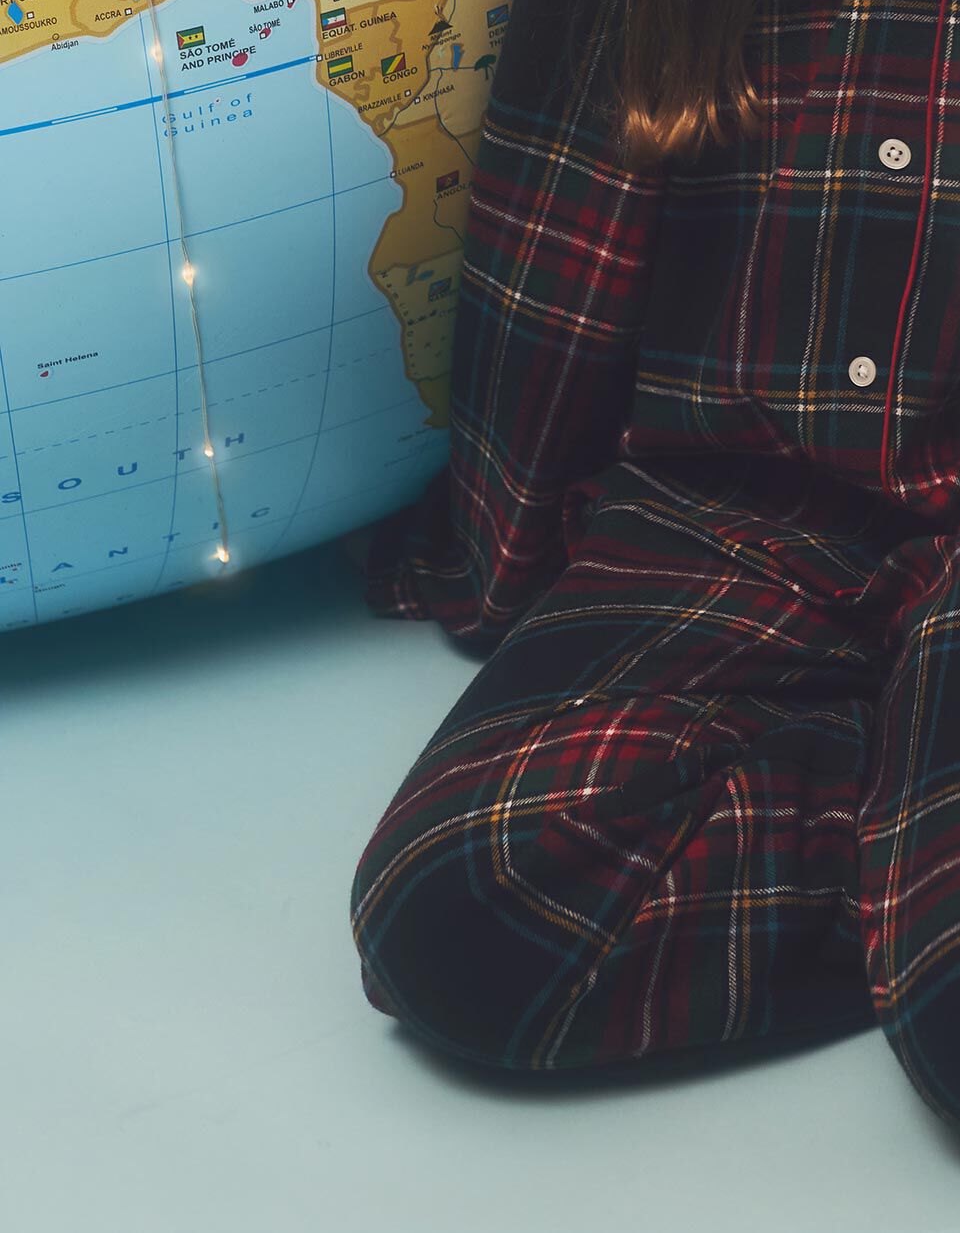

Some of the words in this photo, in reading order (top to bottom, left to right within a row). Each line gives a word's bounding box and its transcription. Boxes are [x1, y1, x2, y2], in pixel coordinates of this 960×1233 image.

[94, 8, 122, 23] ACCRA
[254, 0, 284, 14] MALABO
[0, 16, 58, 37] MOUSSOUKRO
[322, 23, 358, 40] EQUAT.
[360, 11, 398, 30] GUINEA
[51, 39, 79, 52] Abidjan
[180, 46, 203, 60] SÃO
[205, 38, 236, 53] TOMÉ
[324, 42, 364, 60] LIBREVILLE
[181, 58, 204, 72] AND
[328, 70, 366, 88] GABON
[382, 66, 418, 84] CONGO
[422, 84, 456, 102] KINSHASA
[162, 102, 218, 124] Gulf
[230, 92, 253, 108] of
[358, 92, 402, 114] BRAZZAVILLE
[164, 109, 253, 138] Guinea
[398, 161, 424, 176] LUANDA
[37, 358, 62, 370] Saint
[64, 350, 99, 364] Helena
[1, 432, 244, 504] SOUTH
